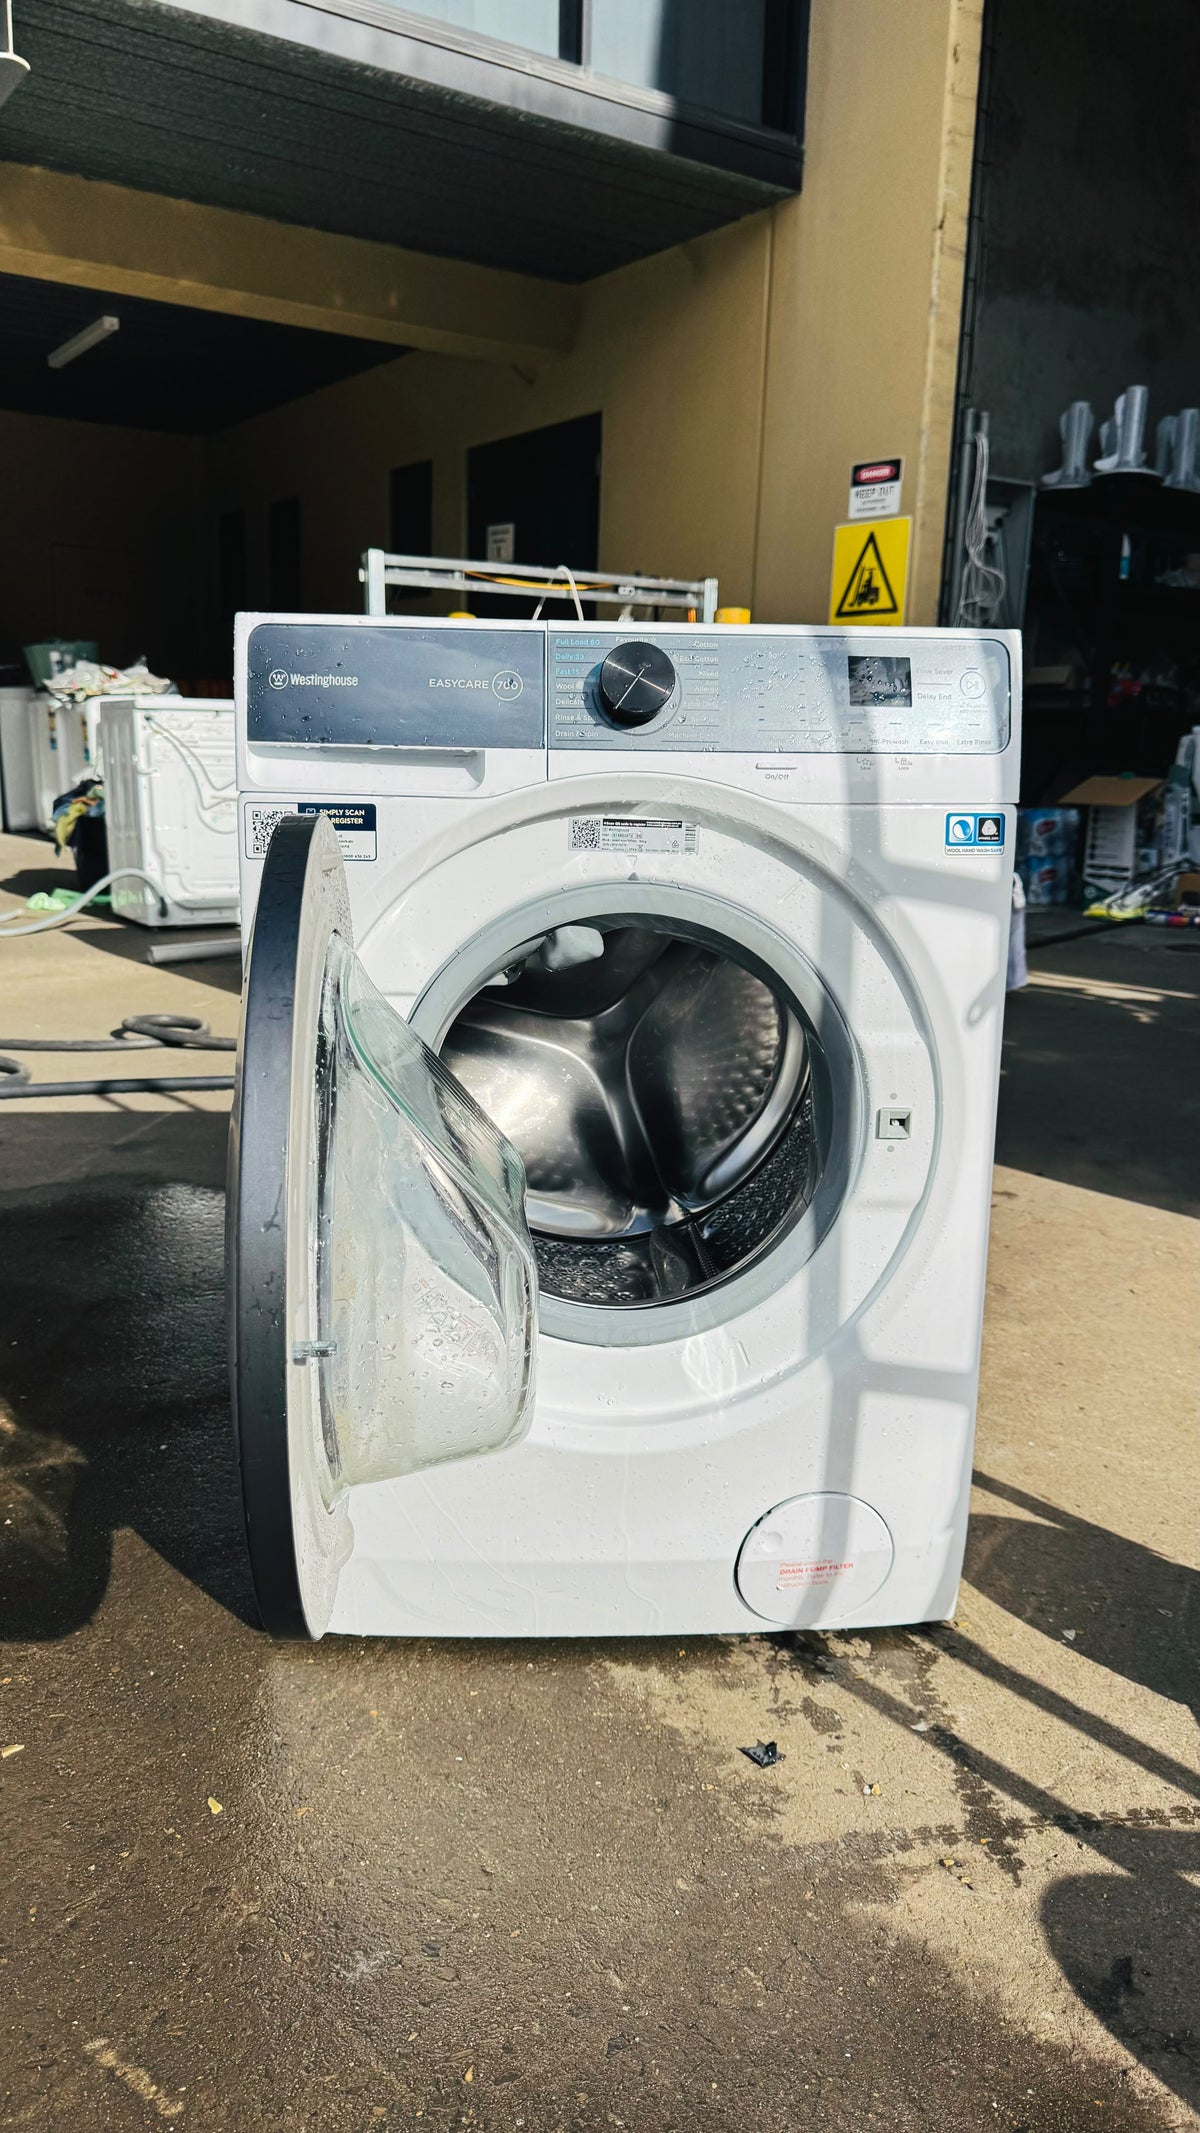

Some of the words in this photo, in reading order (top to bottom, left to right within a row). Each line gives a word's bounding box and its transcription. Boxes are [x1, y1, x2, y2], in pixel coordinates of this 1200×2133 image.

[556, 653, 572, 661] Daily
[290, 672, 359, 688] Westinghouse
[429, 678, 489, 689] EASYCARE
[497, 680, 519, 691] 700
[765, 773, 790, 781] On/Off
[805, 1565, 827, 1573] PUMP
